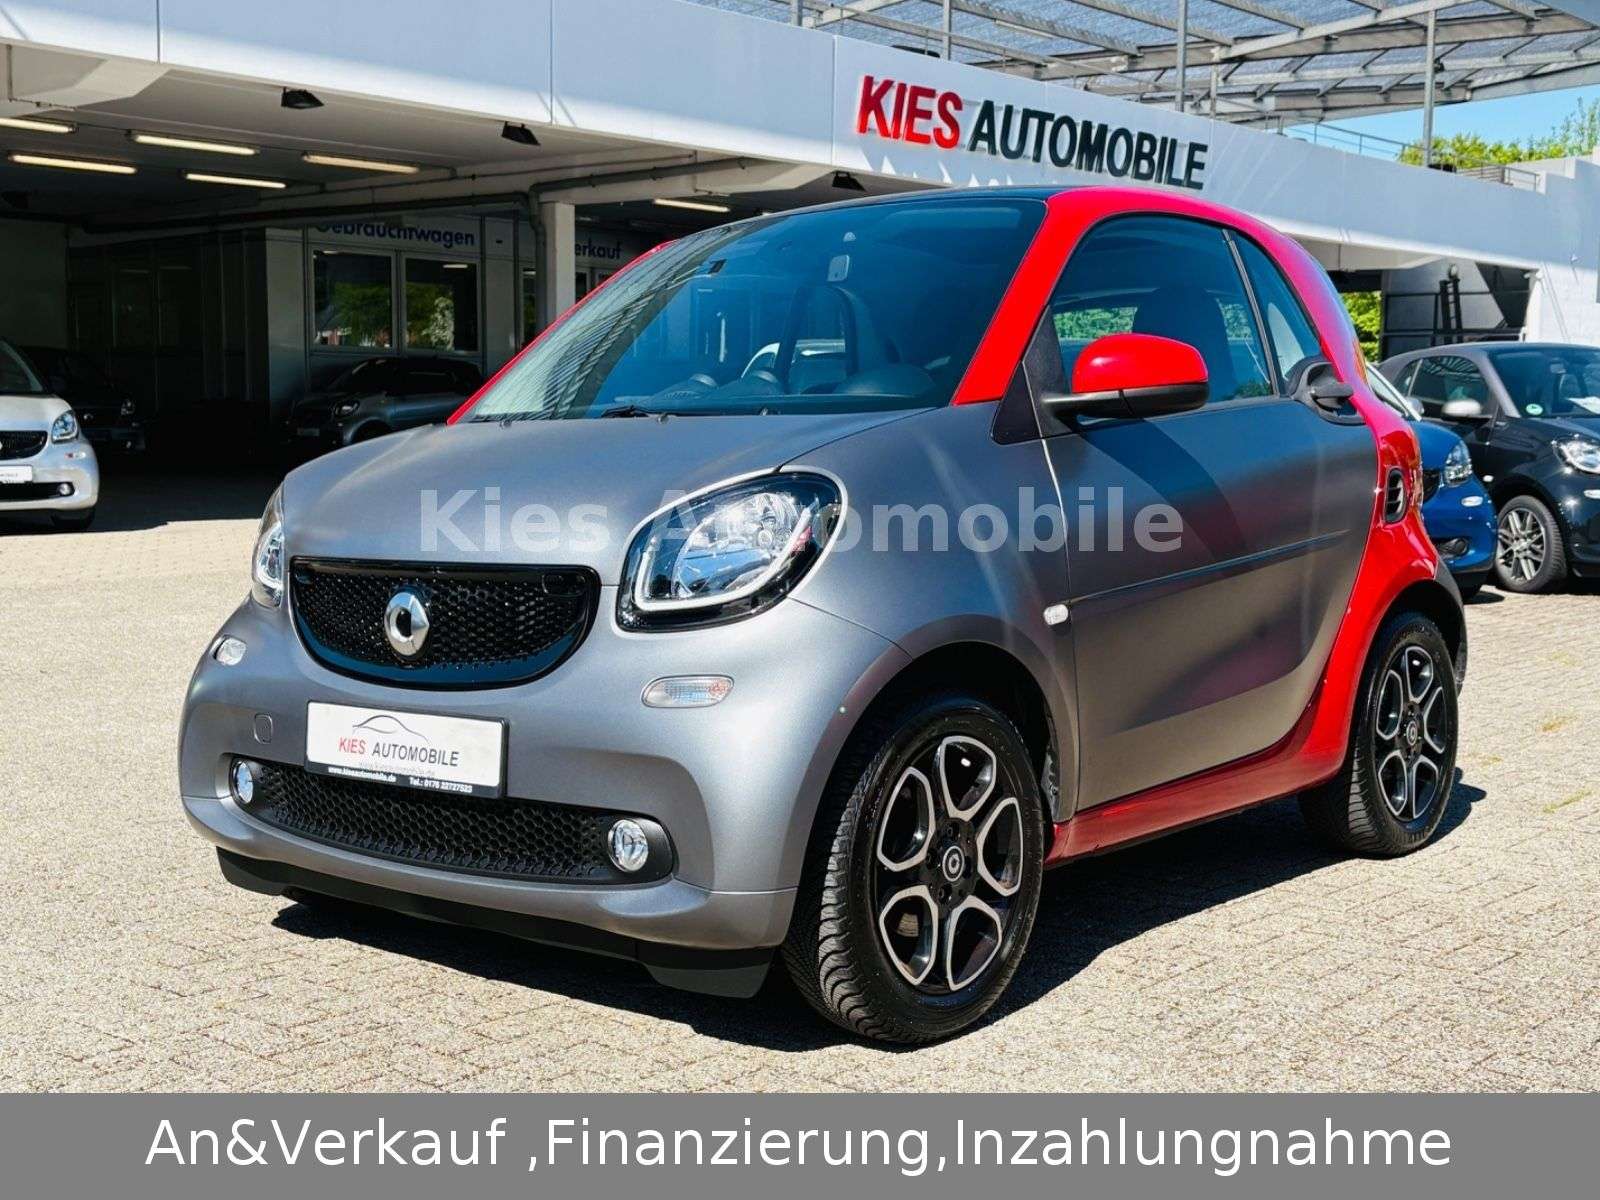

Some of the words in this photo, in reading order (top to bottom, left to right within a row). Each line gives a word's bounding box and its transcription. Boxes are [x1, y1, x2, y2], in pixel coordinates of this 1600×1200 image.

[856, 75, 963, 149] KIES
[966, 100, 1208, 190] AUTOMOBILE
[575, 238, 622, 259] erkauf
[338, 737, 366, 755] KIES
[371, 742, 459, 767] AUTOMOBILE
